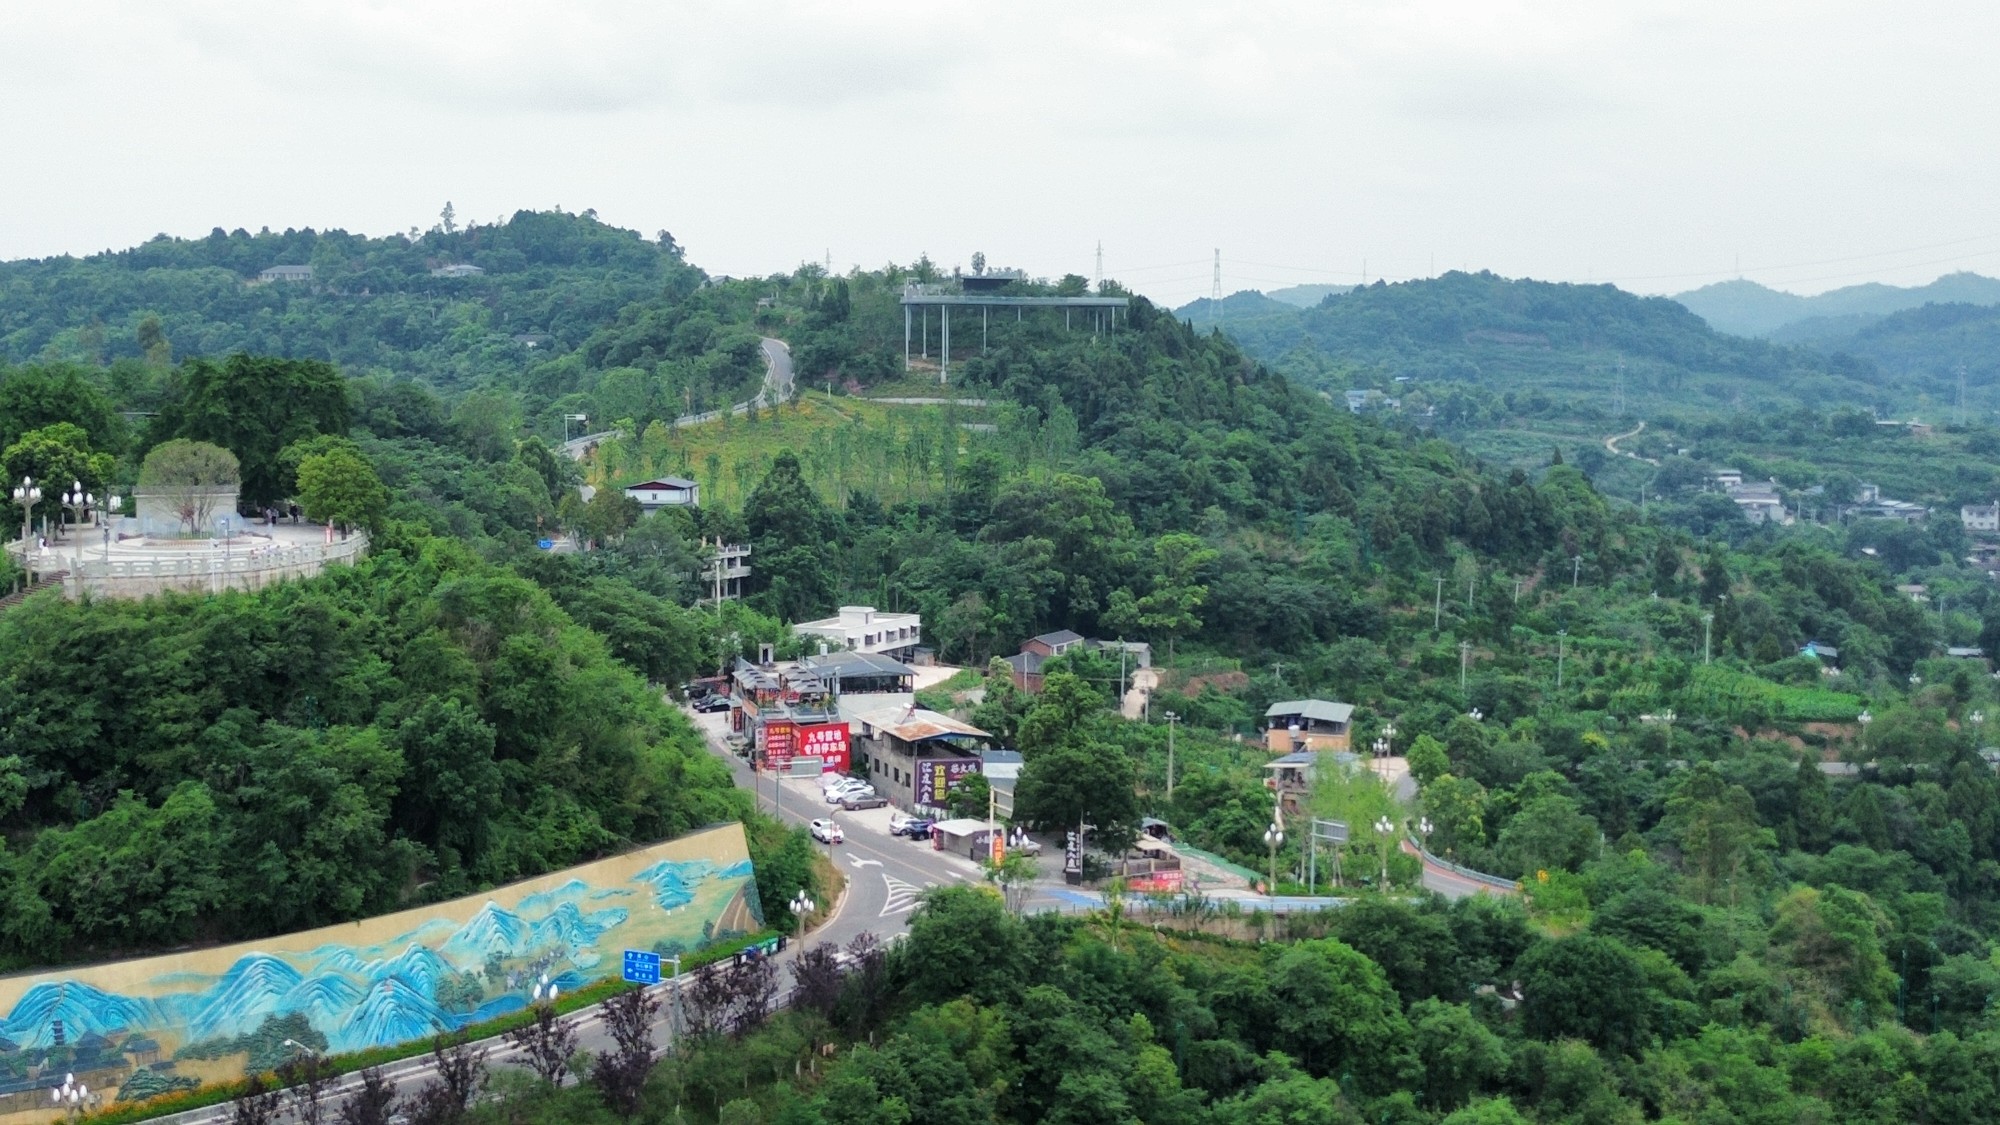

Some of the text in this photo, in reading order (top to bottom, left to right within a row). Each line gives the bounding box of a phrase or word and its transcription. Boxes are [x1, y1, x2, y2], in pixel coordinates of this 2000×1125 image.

[808, 730, 842, 743] 九号营地
[804, 741, 846, 755] 专用停车场
